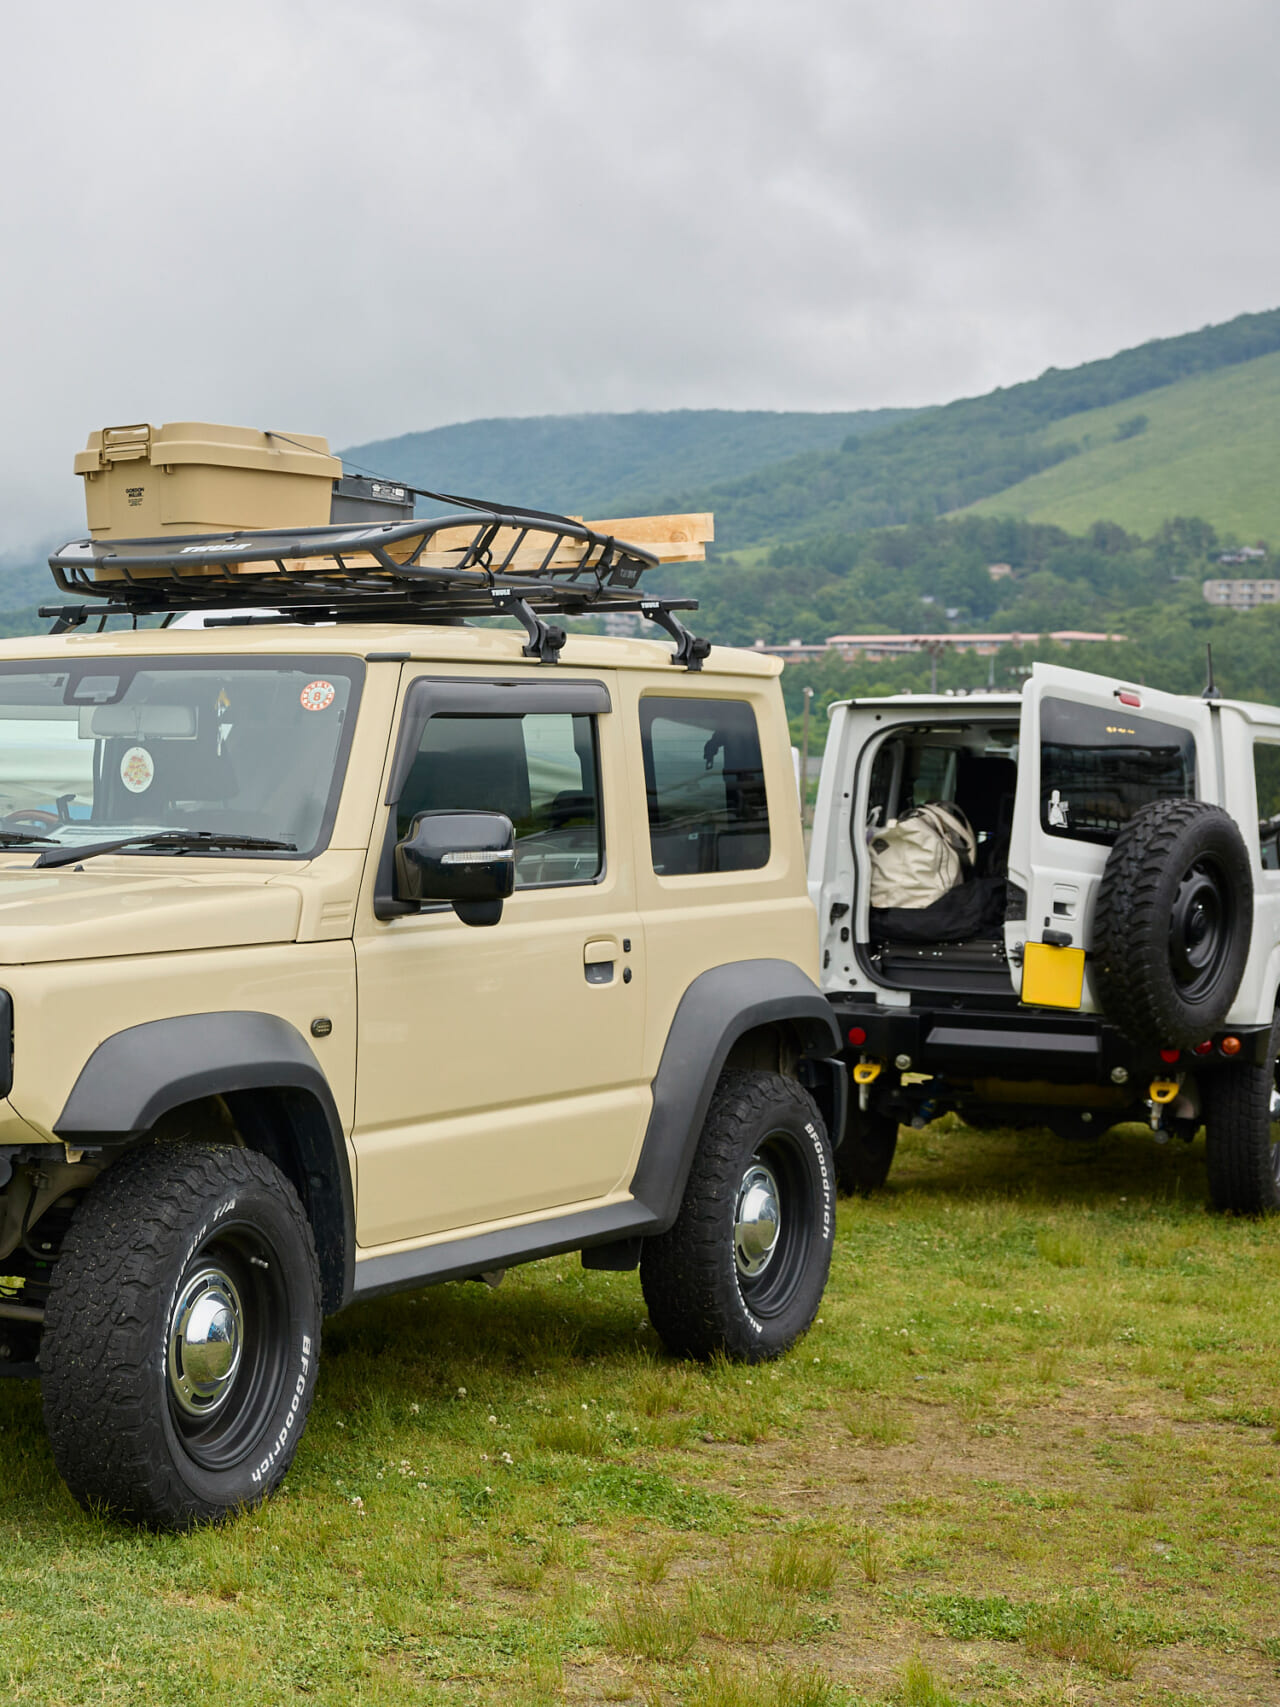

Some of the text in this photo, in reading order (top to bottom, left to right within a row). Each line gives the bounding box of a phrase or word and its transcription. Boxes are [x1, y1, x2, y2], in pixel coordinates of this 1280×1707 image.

[179, 543, 252, 554] THULE
[213, 1199, 236, 1222] T/A
[804, 1122, 831, 1240] BFGoodrich
[251, 1335, 311, 1482] BFGoodrich
